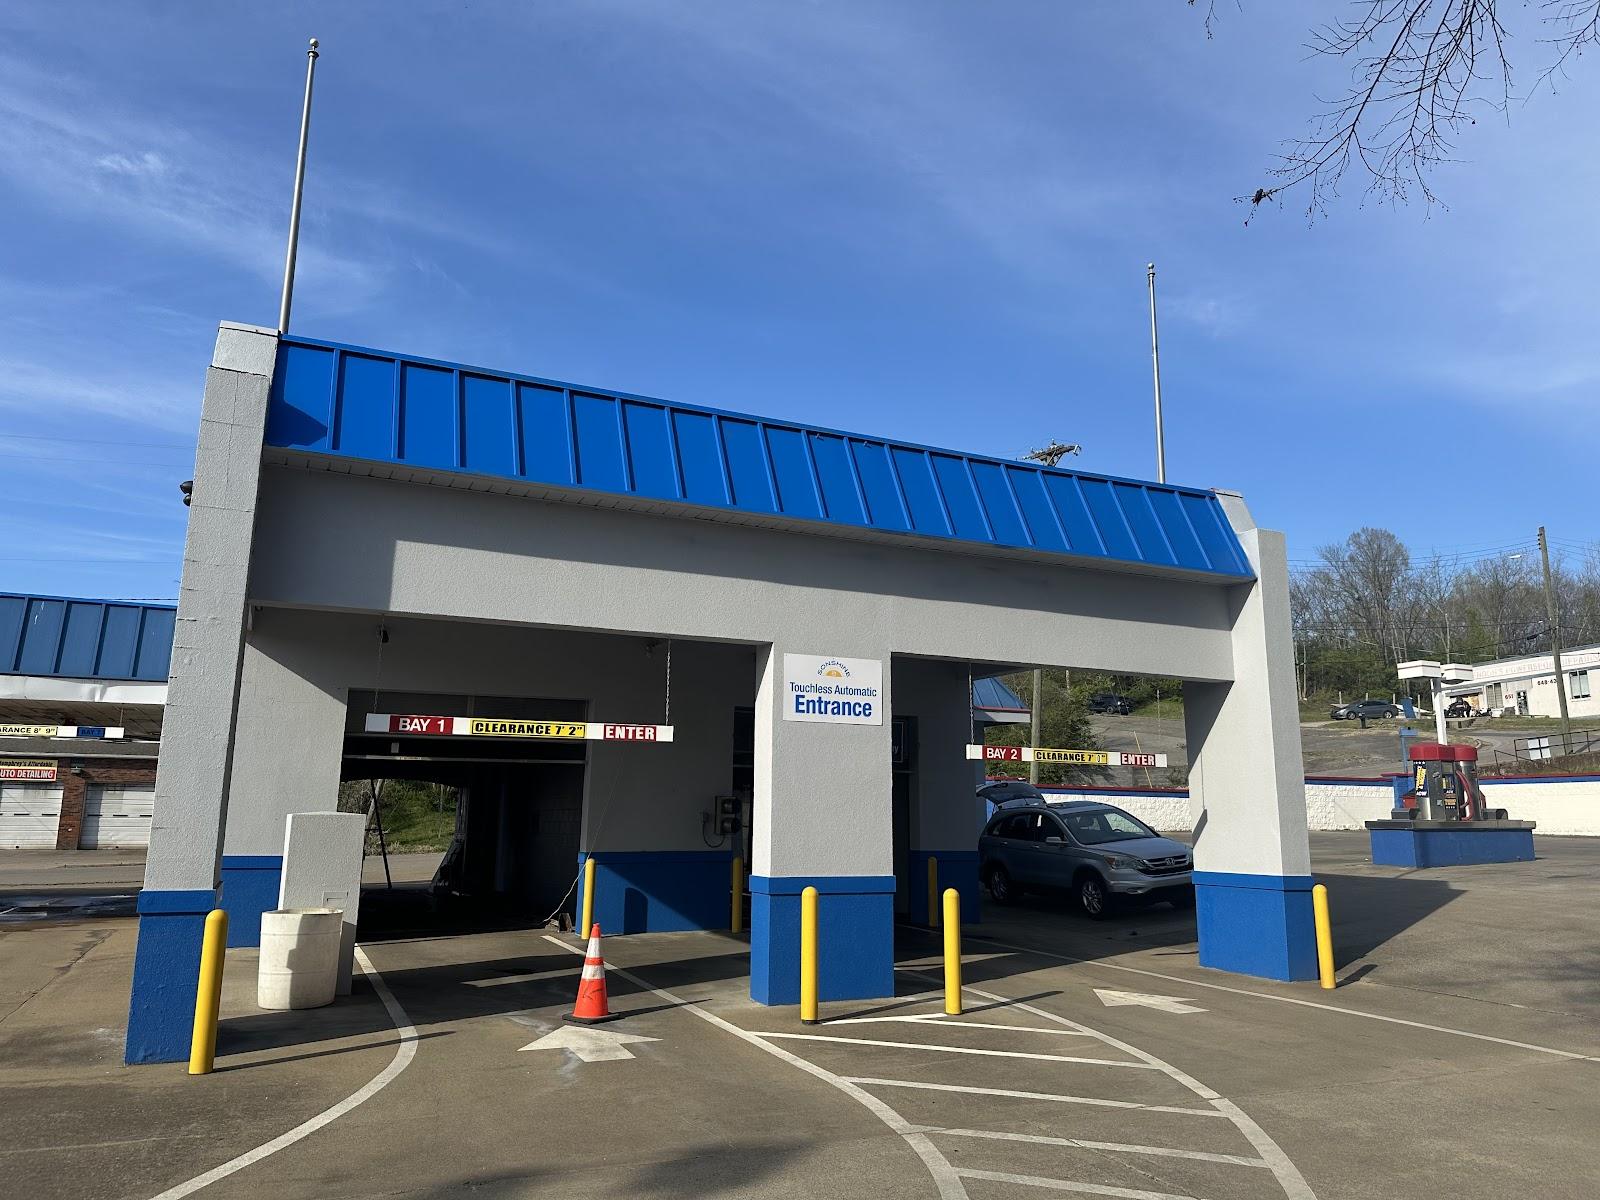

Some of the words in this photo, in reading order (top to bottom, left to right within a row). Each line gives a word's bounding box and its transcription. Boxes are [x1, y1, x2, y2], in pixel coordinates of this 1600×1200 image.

[790, 682, 833, 694] Touchless
[834, 685, 877, 697] Automatic
[796, 694, 872, 716] Entrance
[398, 718, 430, 732] BAY
[437, 719, 446, 733] 1
[474, 722, 551, 735] CLEARANCE
[555, 725, 566, 735] 7'
[568, 725, 583, 736] 2"
[605, 725, 655, 740] ENTER
[986, 747, 1007, 759] BAY
[1010, 748, 1018, 760] 2
[1036, 751, 1085, 762] CLEARANCE
[1121, 753, 1155, 766] ENTER
[17, 769, 54, 779] DETAILING
